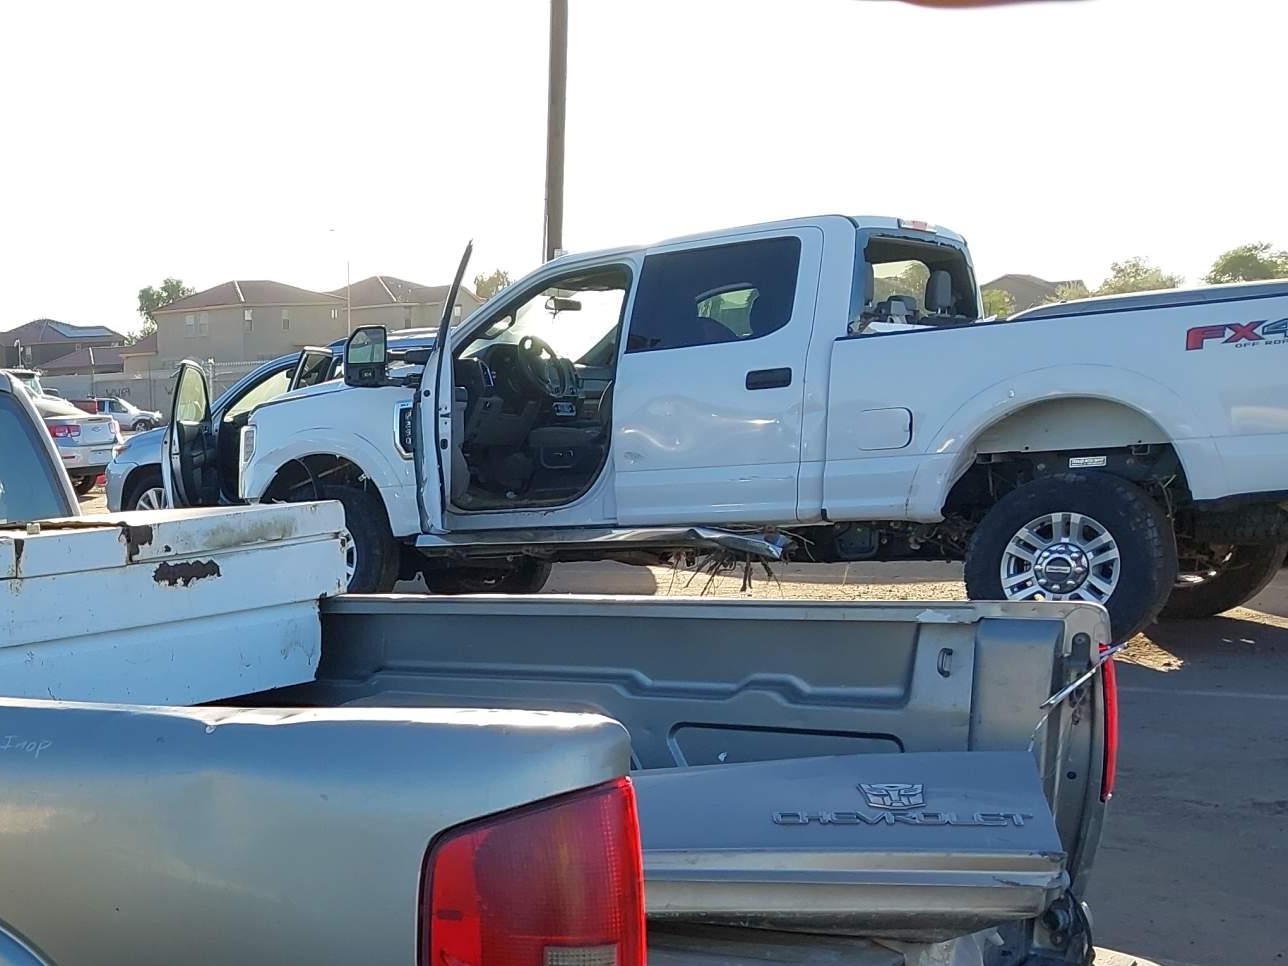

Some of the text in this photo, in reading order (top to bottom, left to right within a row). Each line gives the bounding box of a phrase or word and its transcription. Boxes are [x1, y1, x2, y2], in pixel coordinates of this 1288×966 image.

[1186, 318, 1288, 350] FX4
[1234, 341, 1260, 349] OFF
[771, 810, 1034, 828] CHEVROLET
